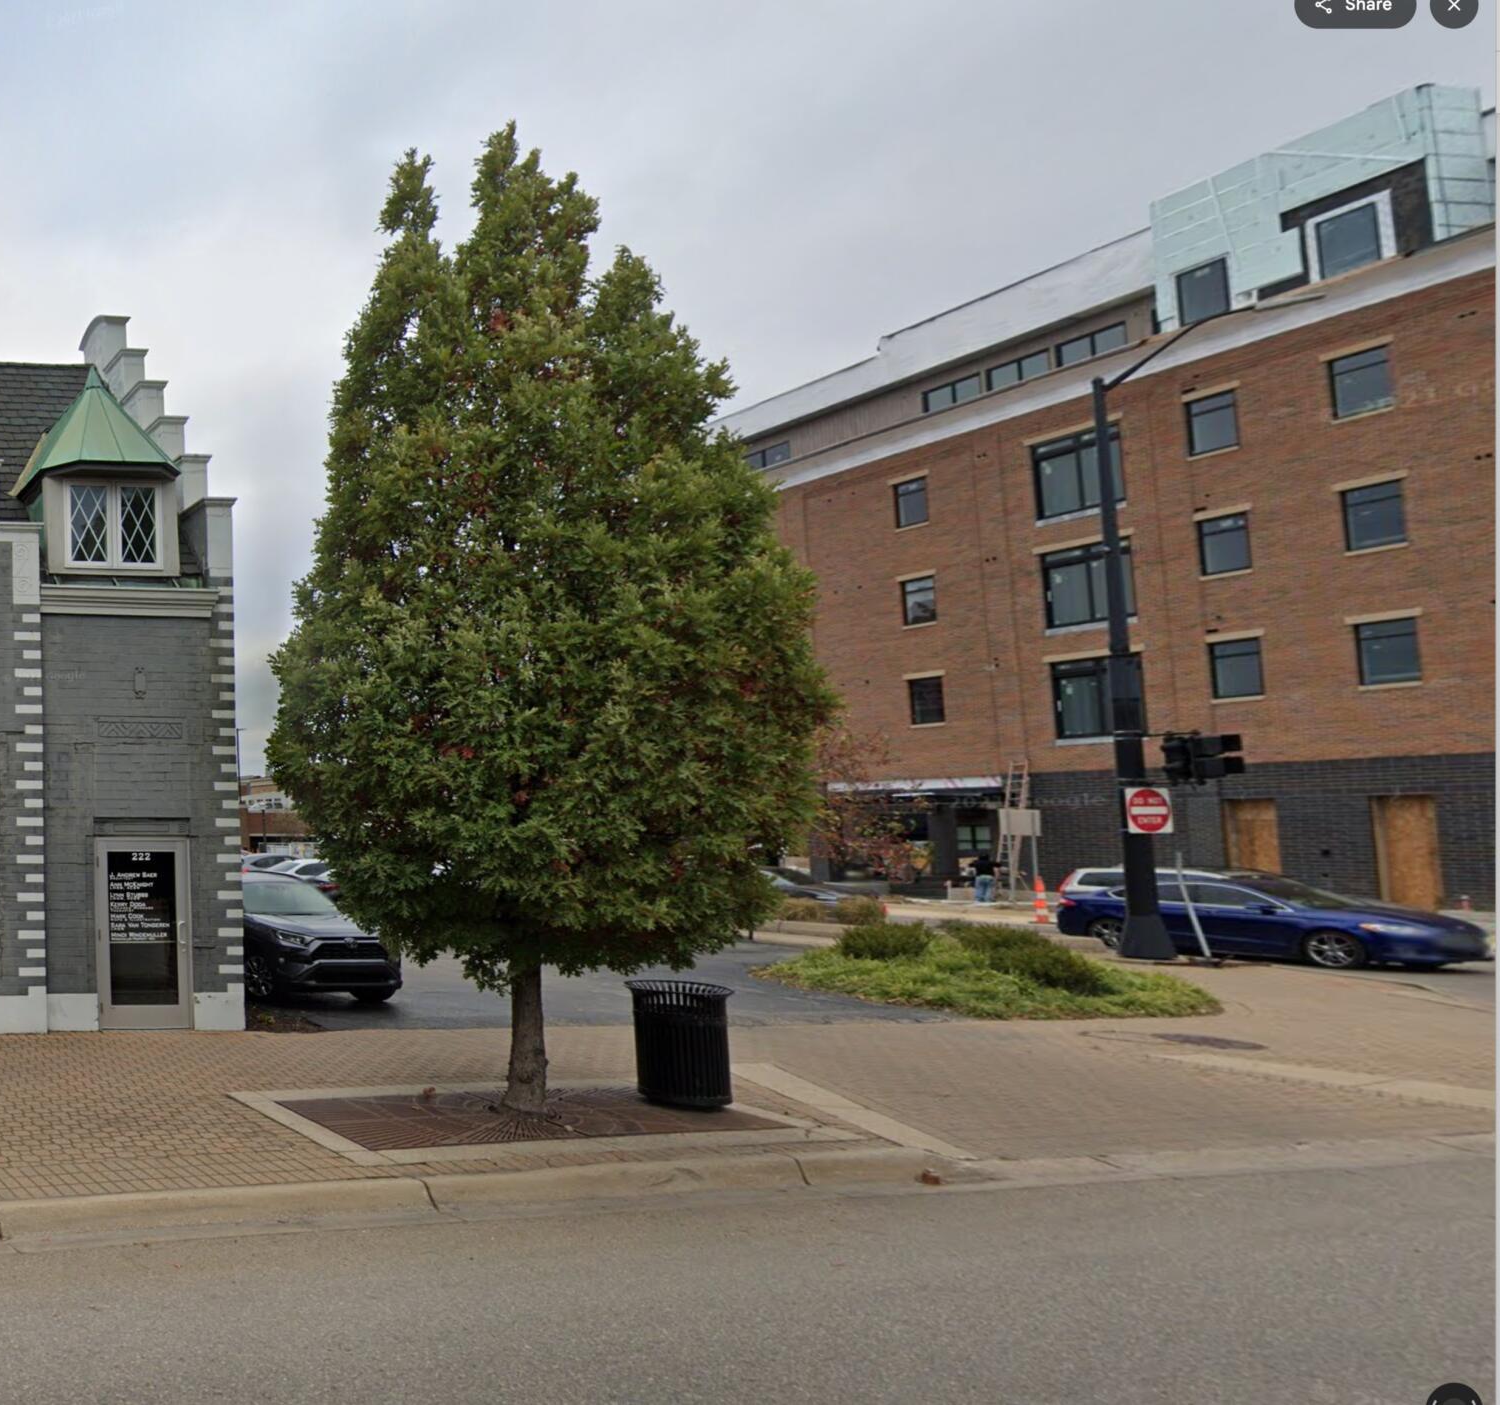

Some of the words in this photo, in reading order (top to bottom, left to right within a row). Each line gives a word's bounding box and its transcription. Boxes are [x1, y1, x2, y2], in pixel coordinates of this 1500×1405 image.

[1132, 797, 1145, 805] DO
[1147, 797, 1163, 805] NOT
[1137, 816, 1162, 825] ENTER
[131, 852, 151, 861] 222
